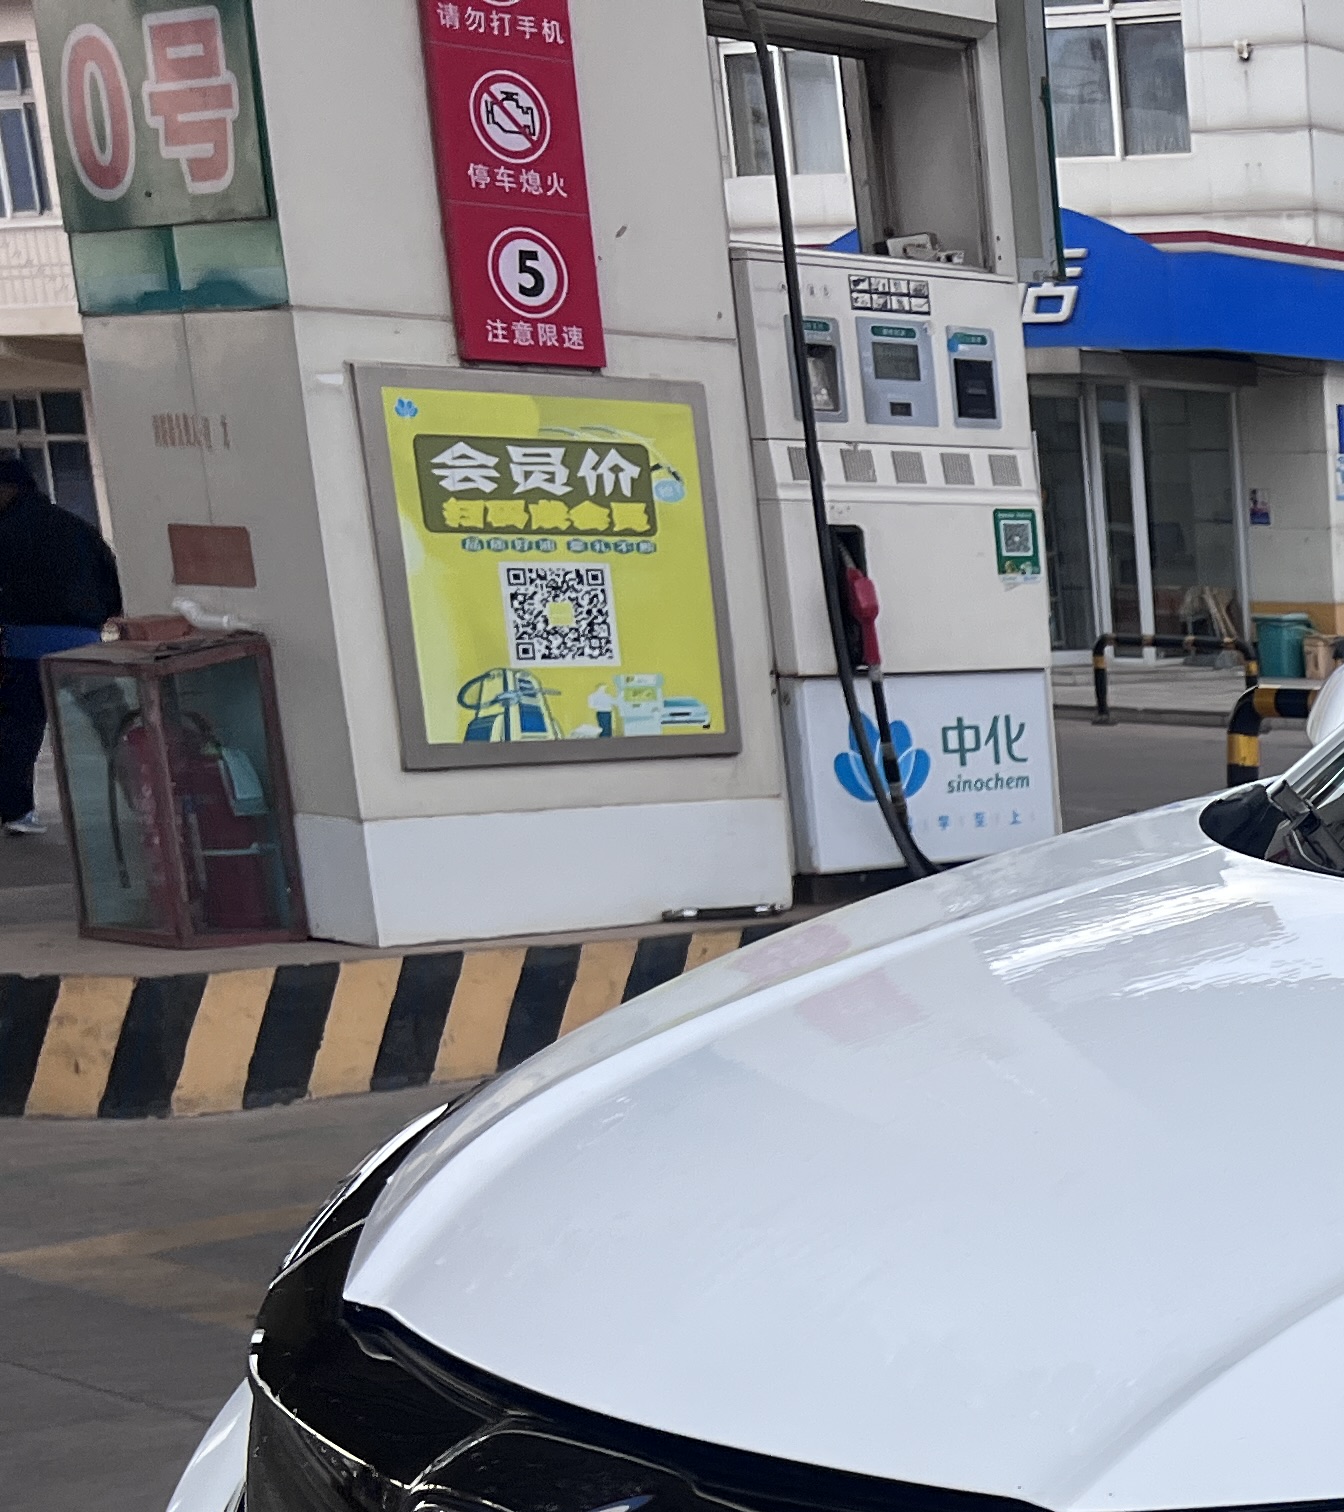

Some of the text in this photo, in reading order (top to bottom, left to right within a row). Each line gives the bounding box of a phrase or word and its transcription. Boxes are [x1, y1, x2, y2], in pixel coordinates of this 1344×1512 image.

[436, 2, 565, 45] 请勿打手机
[61, 5, 239, 203] 0号
[467, 162, 568, 198] 停车熄火
[517, 249, 546, 298] 5
[485, 318, 586, 351] 注意限速
[430, 441, 642, 497] 会员价
[941, 713, 1029, 767] 中化
[947, 773, 1031, 795] sinochem
